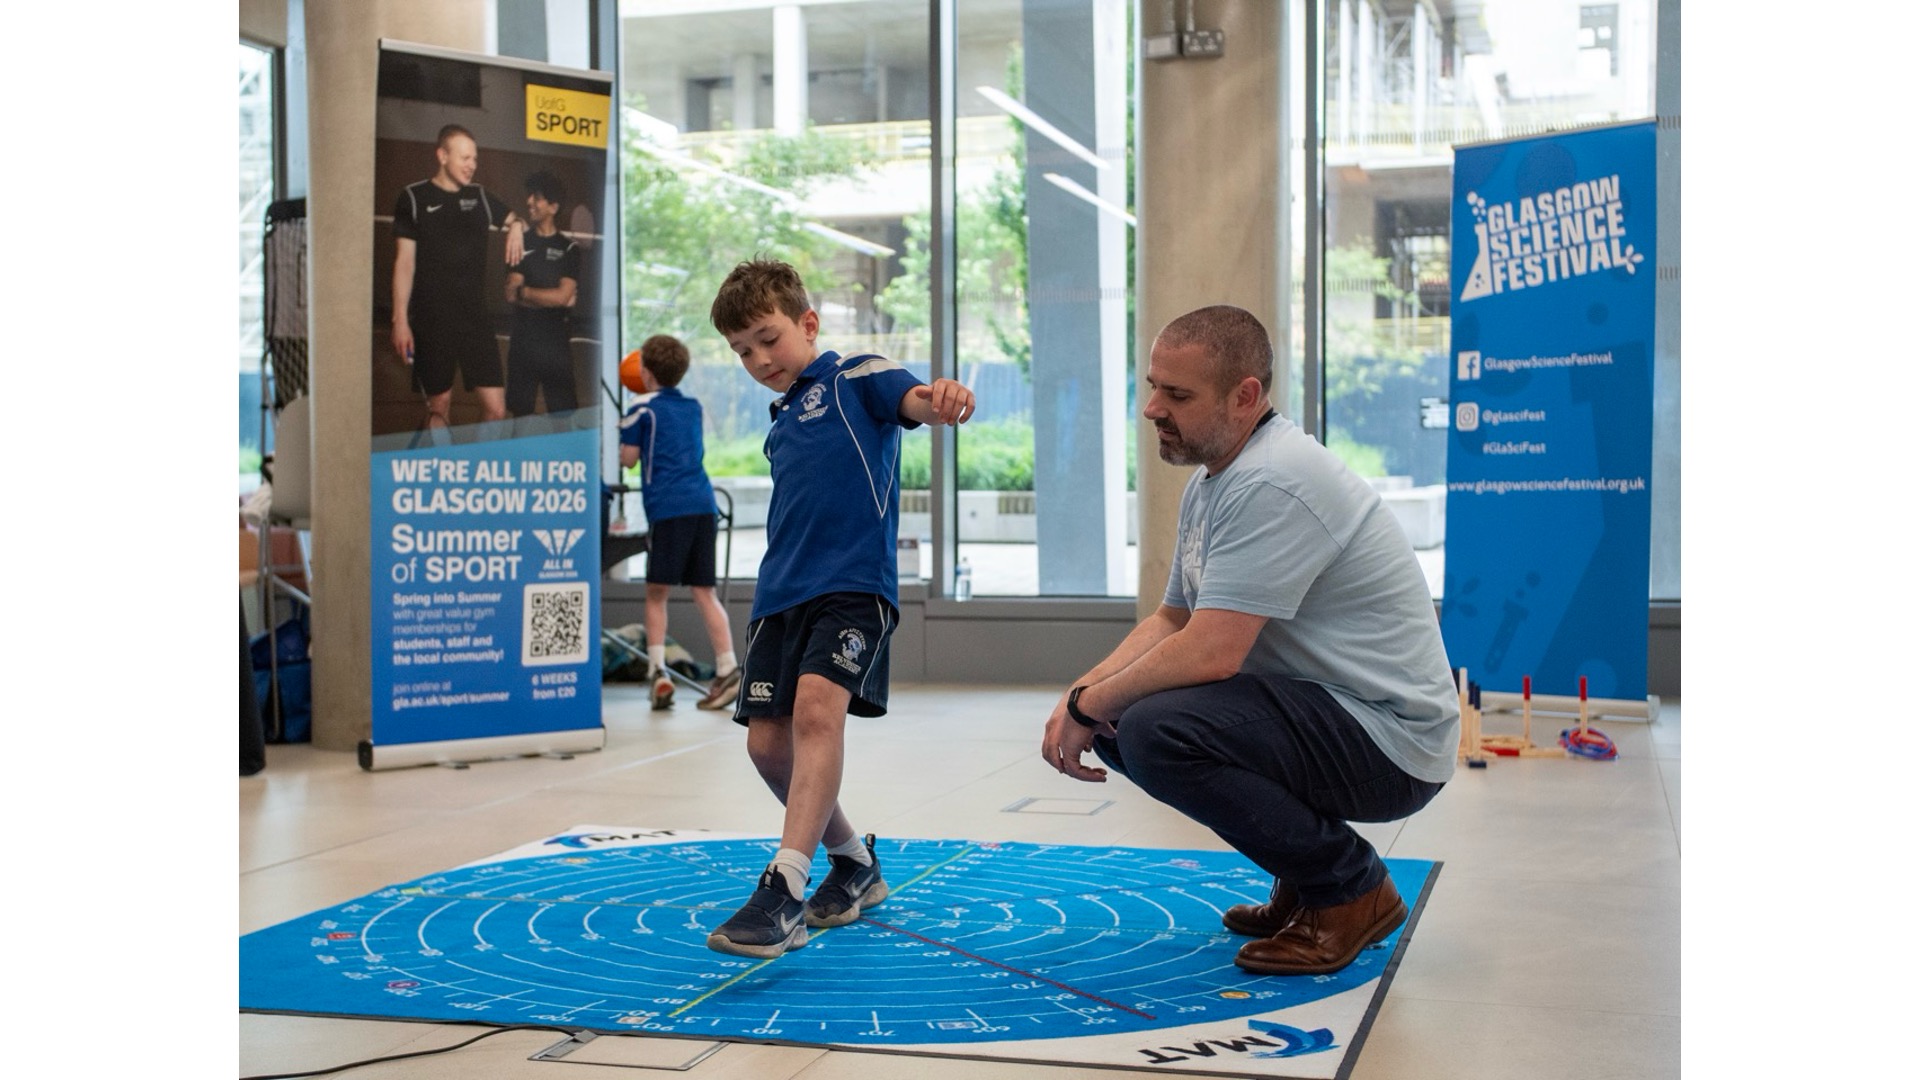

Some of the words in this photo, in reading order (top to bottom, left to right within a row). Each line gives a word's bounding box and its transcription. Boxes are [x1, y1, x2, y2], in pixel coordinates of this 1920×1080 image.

[535, 95, 566, 112] UofG
[536, 111, 602, 137] SPORT
[1487, 174, 1619, 234] GLASGOW
[1490, 200, 1626, 261] SCIENCE
[1492, 237, 1630, 294] FESTIVAL
[1484, 351, 1613, 372] GlasgowScienceFestival
[1483, 441, 1546, 454] #GlaSciFest
[391, 458, 470, 483] WE’RE
[474, 460, 516, 483] ALL
[521, 461, 543, 483] IN
[547, 461, 587, 483] FOR
[1448, 476, 1645, 495] www.glasgowsciencefestival.org.uk
[392, 488, 527, 514] GLASGOW
[531, 489, 587, 513] 2026
[392, 523, 522, 554] Summer
[392, 557, 417, 583] of
[426, 556, 522, 582] SPORT
[543, 559, 561, 570] ALL
[562, 559, 574, 569] IN
[393, 592, 430, 607] Spring
[434, 592, 454, 604] into
[458, 591, 502, 604] Summer
[393, 607, 414, 619] with
[417, 608, 442, 621] great
[445, 606, 471, 619] value
[473, 607, 495, 620] gym
[393, 622, 462, 636] memberships
[464, 621, 477, 632] for
[393, 636, 444, 650] students,
[447, 635, 471, 648] staff
[473, 634, 493, 647] and
[393, 652, 411, 665] the
[413, 651, 440, 664] local
[442, 649, 504, 664] community!
[532, 675, 539, 685] 6
[541, 672, 578, 684] WEEKS
[393, 682, 411, 695] join
[413, 681, 440, 692] online
[442, 680, 452, 691] at
[532, 686, 556, 699] from
[557, 685, 577, 698] £20
[392, 691, 510, 711] gla.ac.uk/sport/summer
[951, 960, 982, 968] 50
[979, 971, 1010, 979] 60
[676, 983, 708, 991] 70
[1010, 981, 1045, 990] 70
[1044, 993, 1078, 1002] 80
[1077, 1005, 1114, 1015] 90
[1137, 1034, 1282, 1064] MAT
